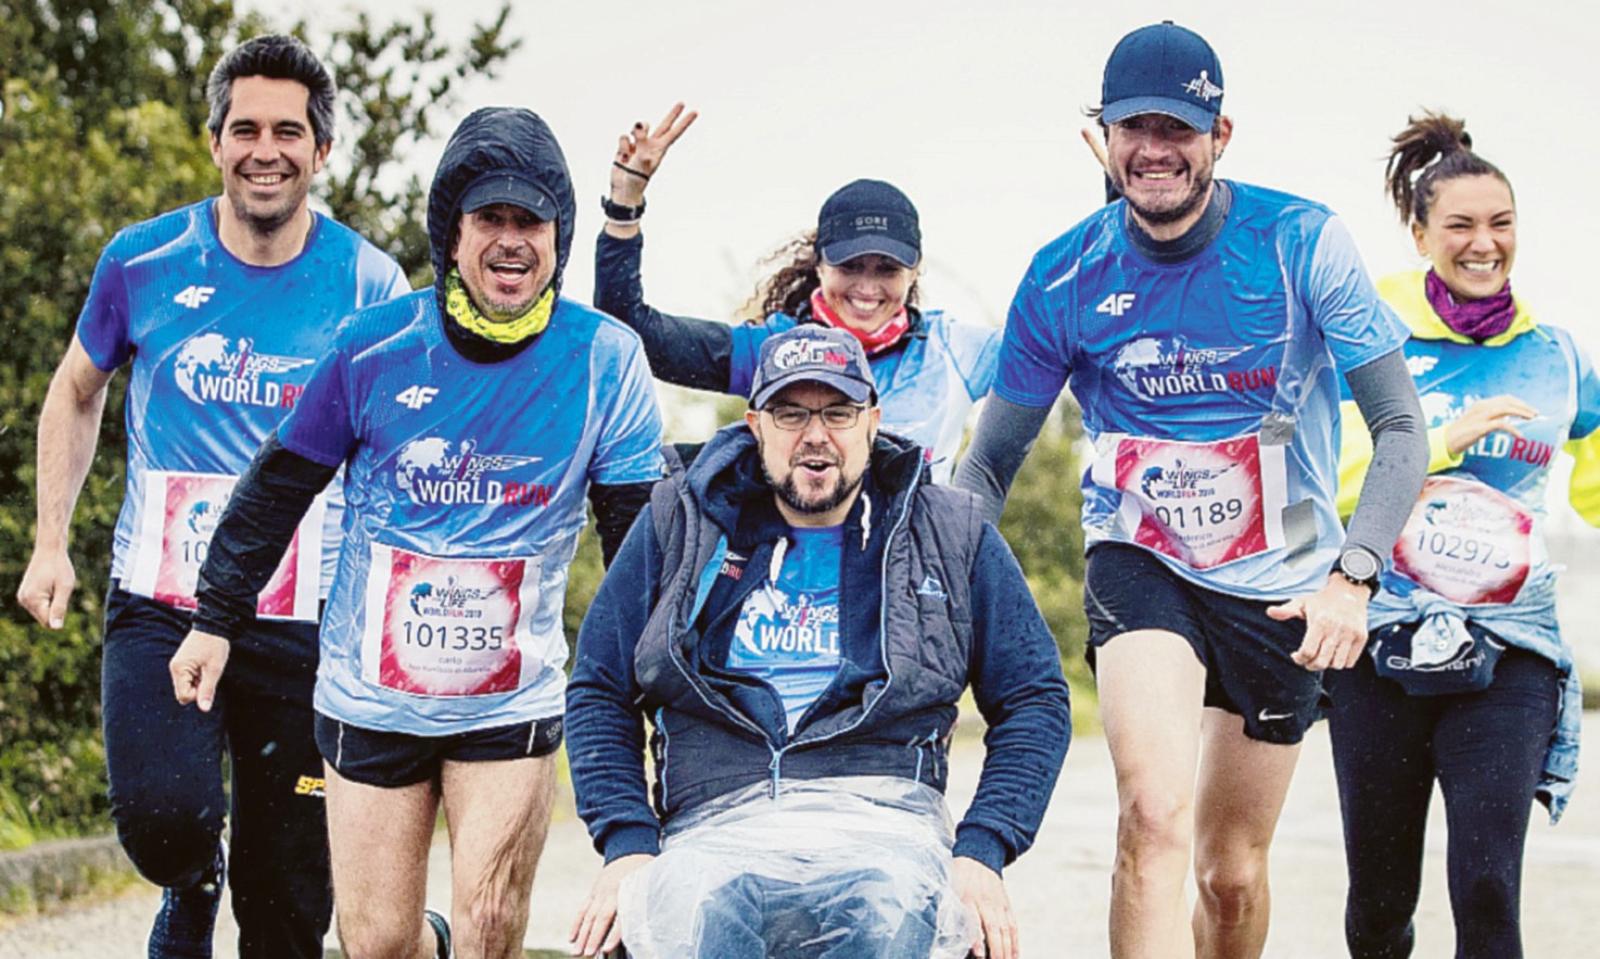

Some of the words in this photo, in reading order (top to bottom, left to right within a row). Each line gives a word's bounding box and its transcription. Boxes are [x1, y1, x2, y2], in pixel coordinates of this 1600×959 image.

[855, 216, 888, 226] GORE
[173, 285, 216, 309] 4F
[1096, 293, 1136, 316] 4F
[396, 385, 439, 411] 4F
[403, 621, 504, 651] 101335
